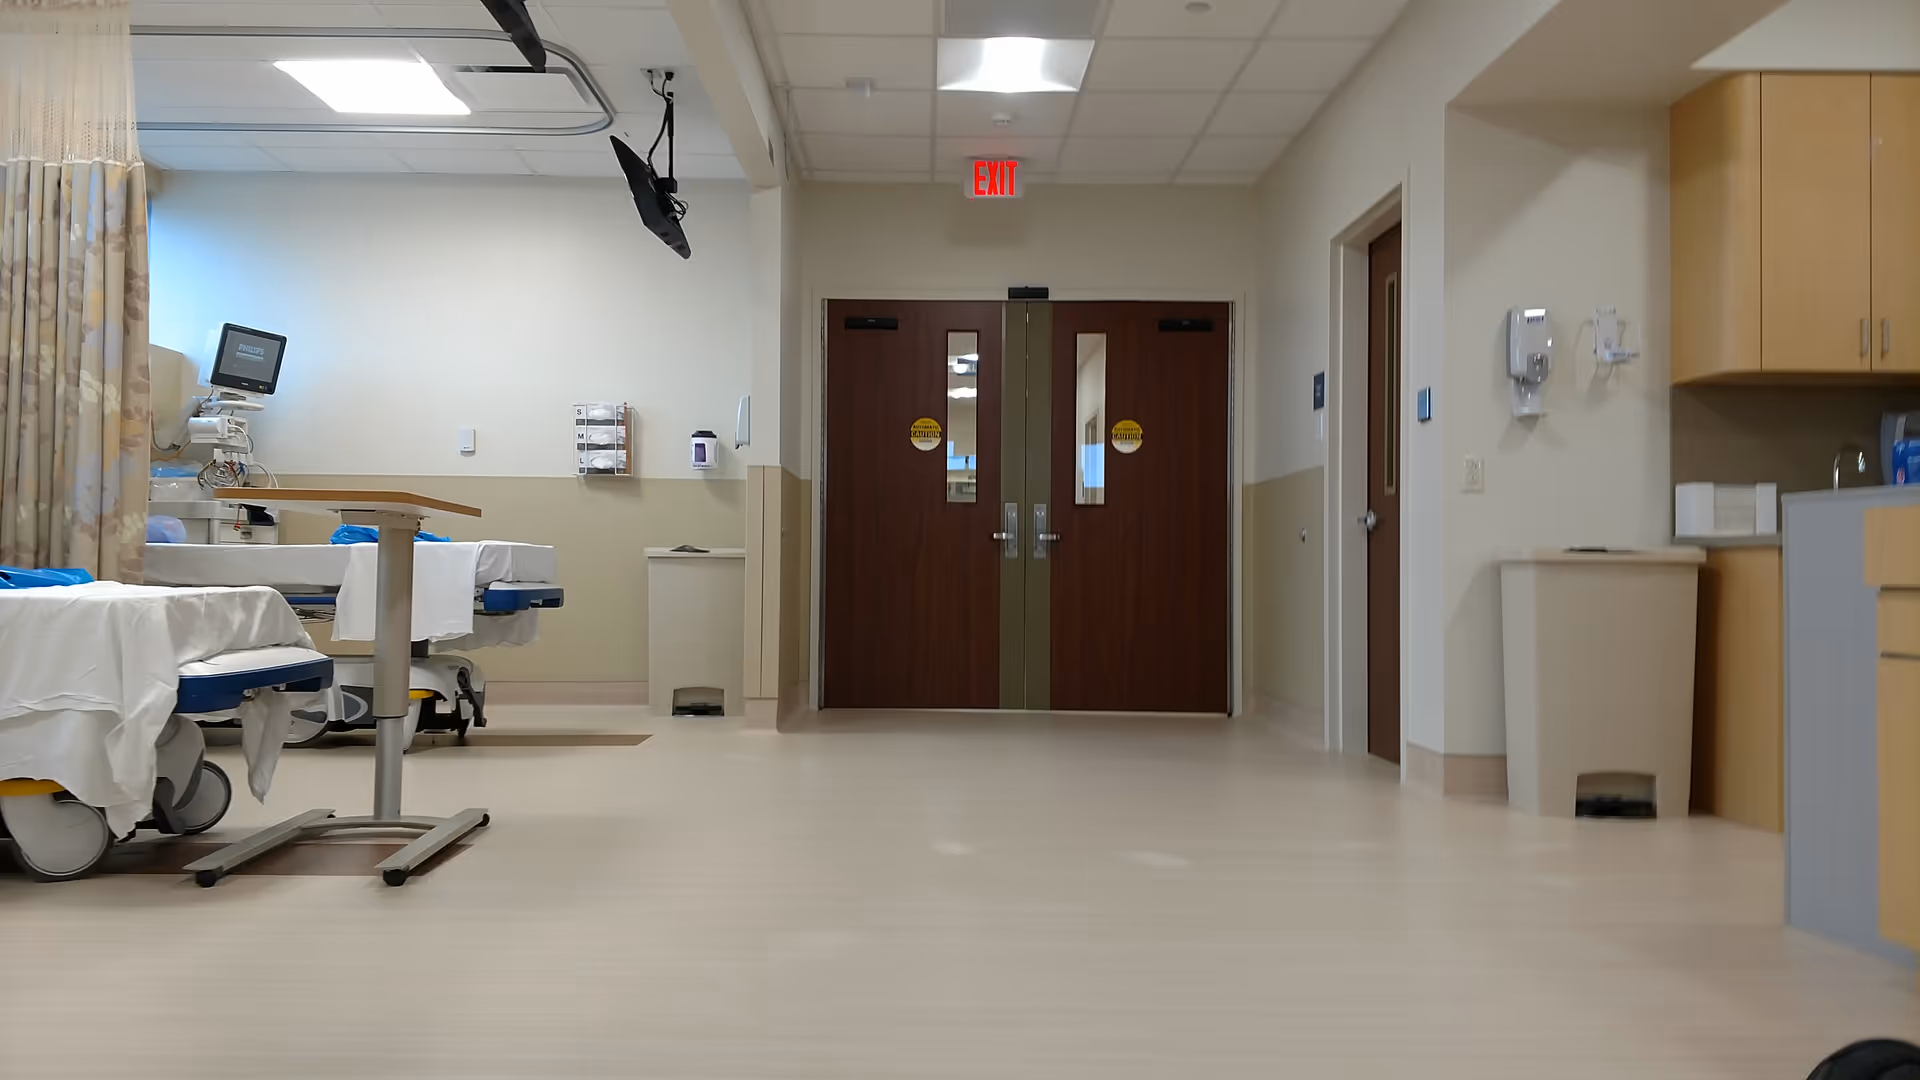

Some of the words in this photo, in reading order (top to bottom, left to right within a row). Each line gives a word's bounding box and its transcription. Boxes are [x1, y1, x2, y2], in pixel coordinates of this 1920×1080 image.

[974, 160, 1018, 196] EXIT
[238, 343, 265, 356] PHILIPS
[576, 408, 582, 416] S
[911, 430, 940, 438] CAUTION
[1112, 432, 1142, 440] CAUTION
